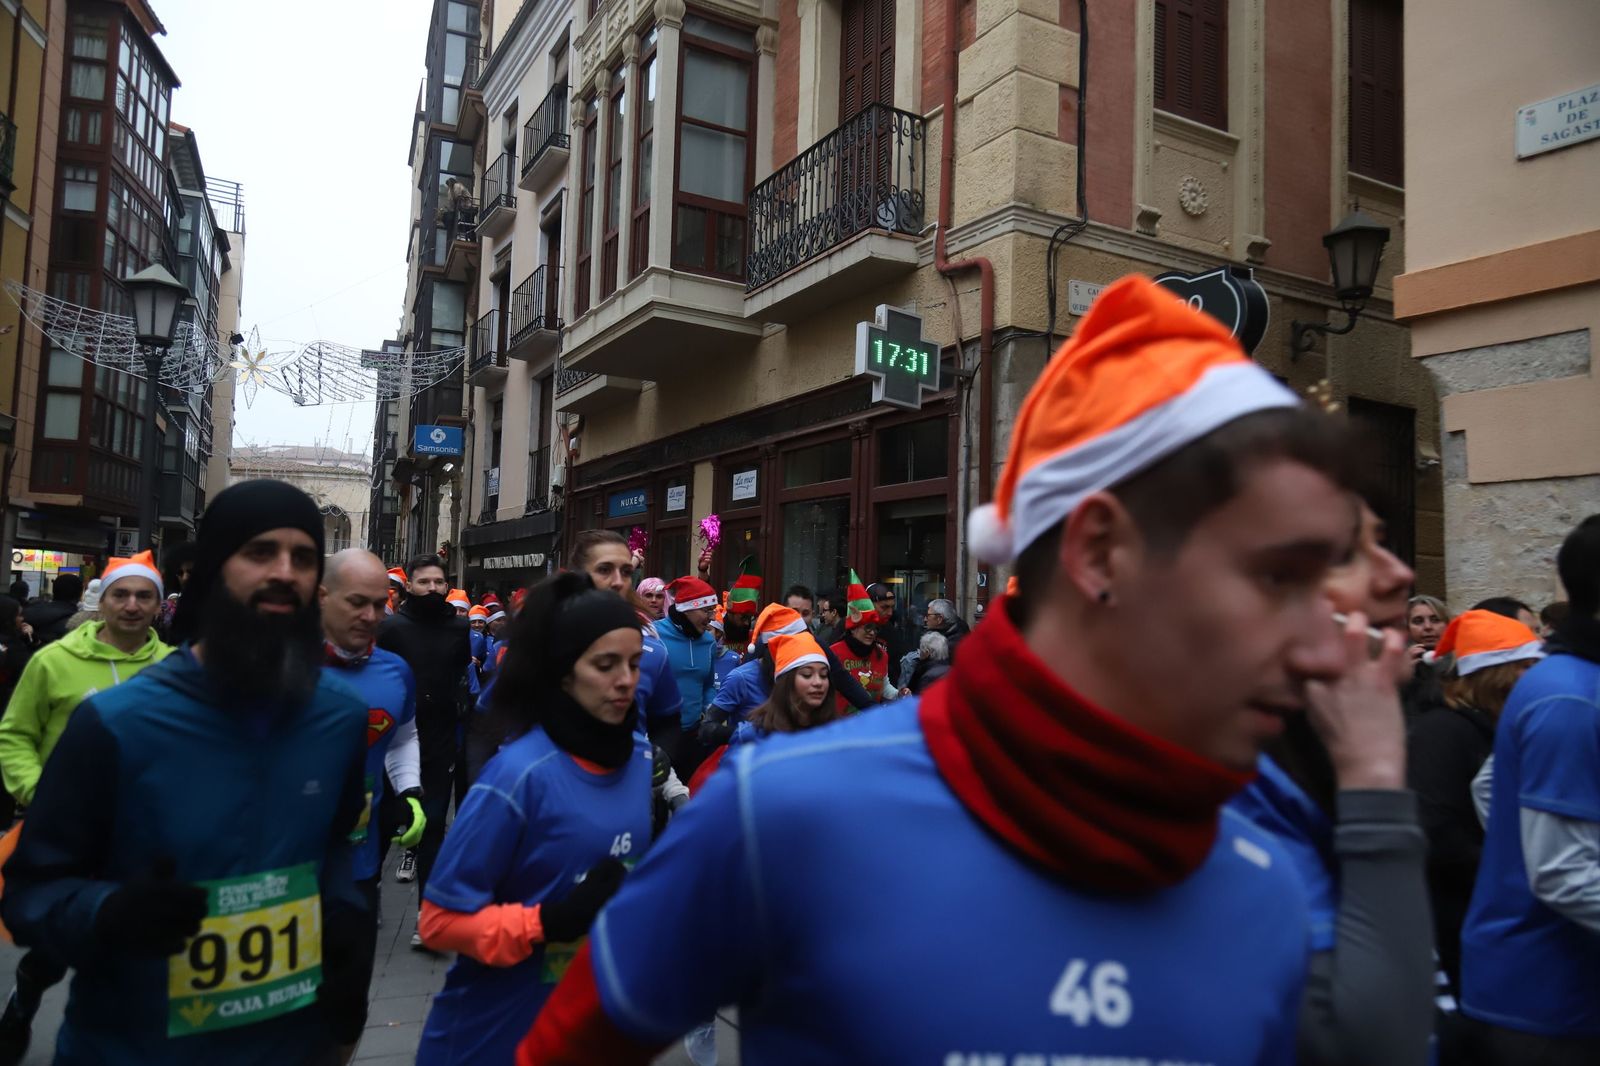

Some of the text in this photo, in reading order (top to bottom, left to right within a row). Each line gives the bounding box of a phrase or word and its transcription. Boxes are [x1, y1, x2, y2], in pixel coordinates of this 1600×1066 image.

[1558, 92, 1599, 113] PLAZ
[1567, 109, 1589, 124] DE
[1541, 119, 1600, 145] SAGAST
[874, 340, 928, 375] 17:31
[417, 444, 458, 453] Samsonite
[621, 496, 638, 507] NUXE
[609, 832, 632, 857] 46
[189, 915, 299, 991] 991
[218, 978, 317, 1017] CAJA RURAL
[1050, 958, 1132, 1028] 46
